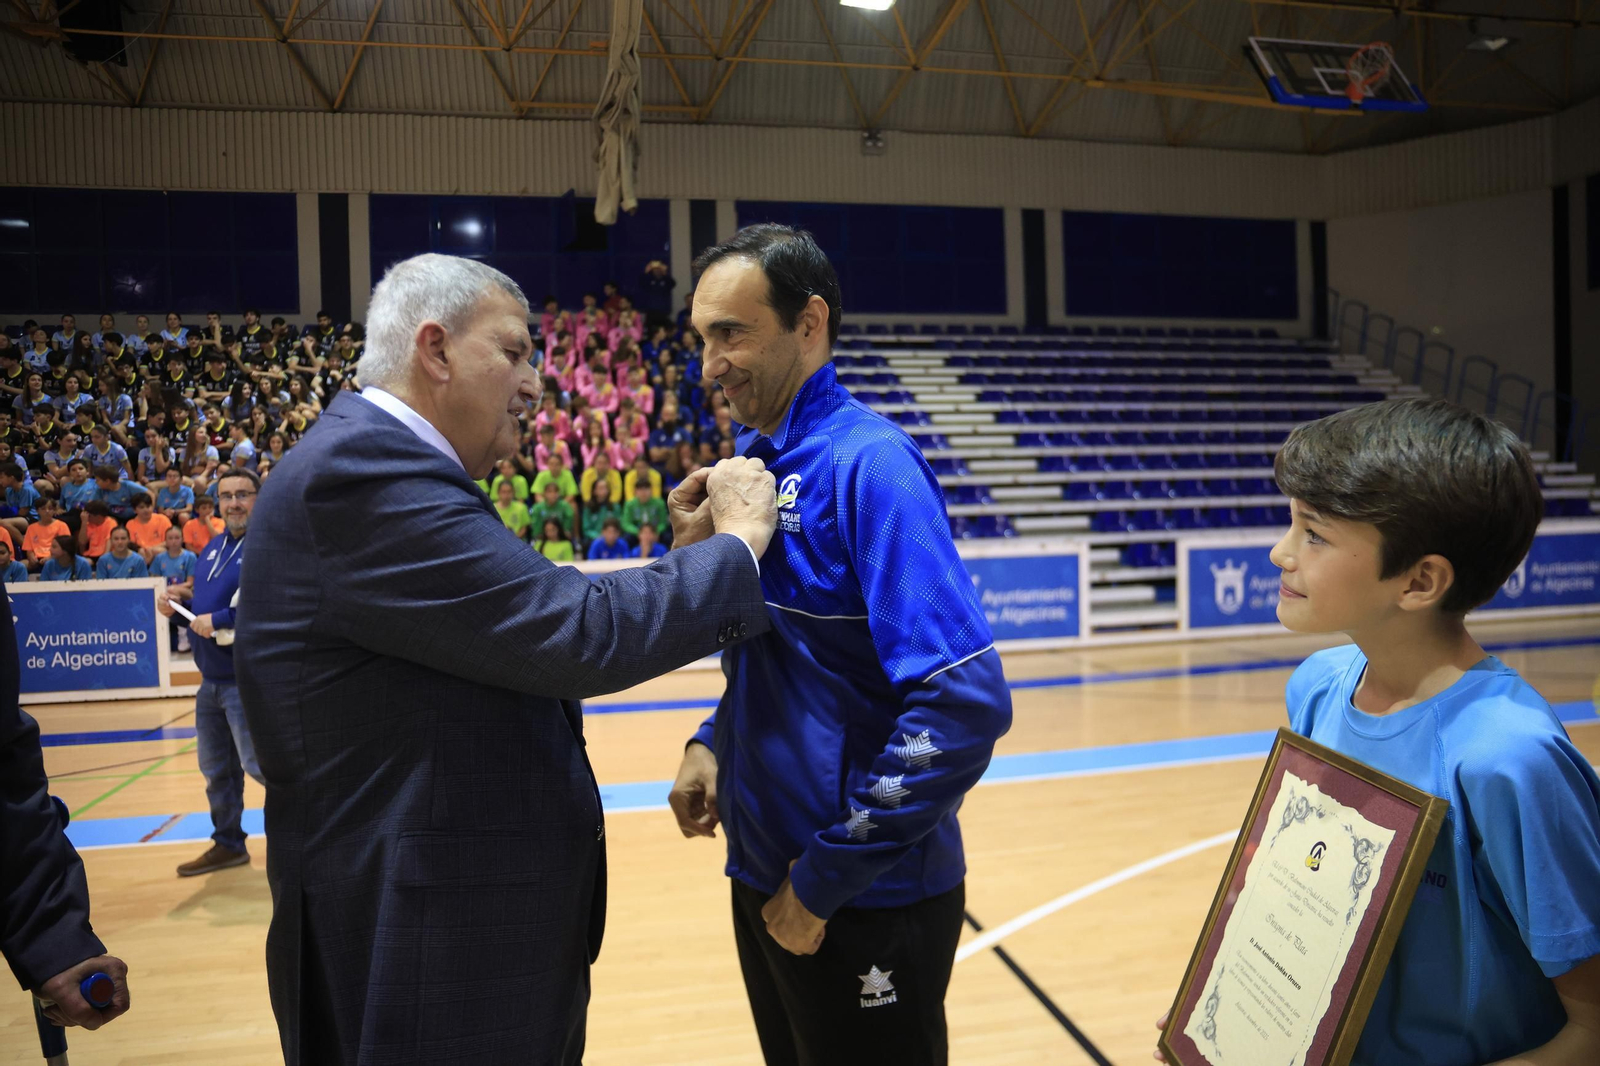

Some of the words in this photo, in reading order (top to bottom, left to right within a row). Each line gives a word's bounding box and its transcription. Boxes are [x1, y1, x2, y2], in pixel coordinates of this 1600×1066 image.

[25, 628, 147, 649] Ayuntamiento
[27, 656, 46, 669] de
[51, 650, 138, 670] Algeciras
[1284, 931, 1292, 941] de
[1293, 935, 1308, 956] Plata
[1253, 941, 1263, 952] José
[1262, 949, 1276, 965] Antonio
[1287, 974, 1302, 991] Orozco
[860, 991, 898, 1008] luanvi
